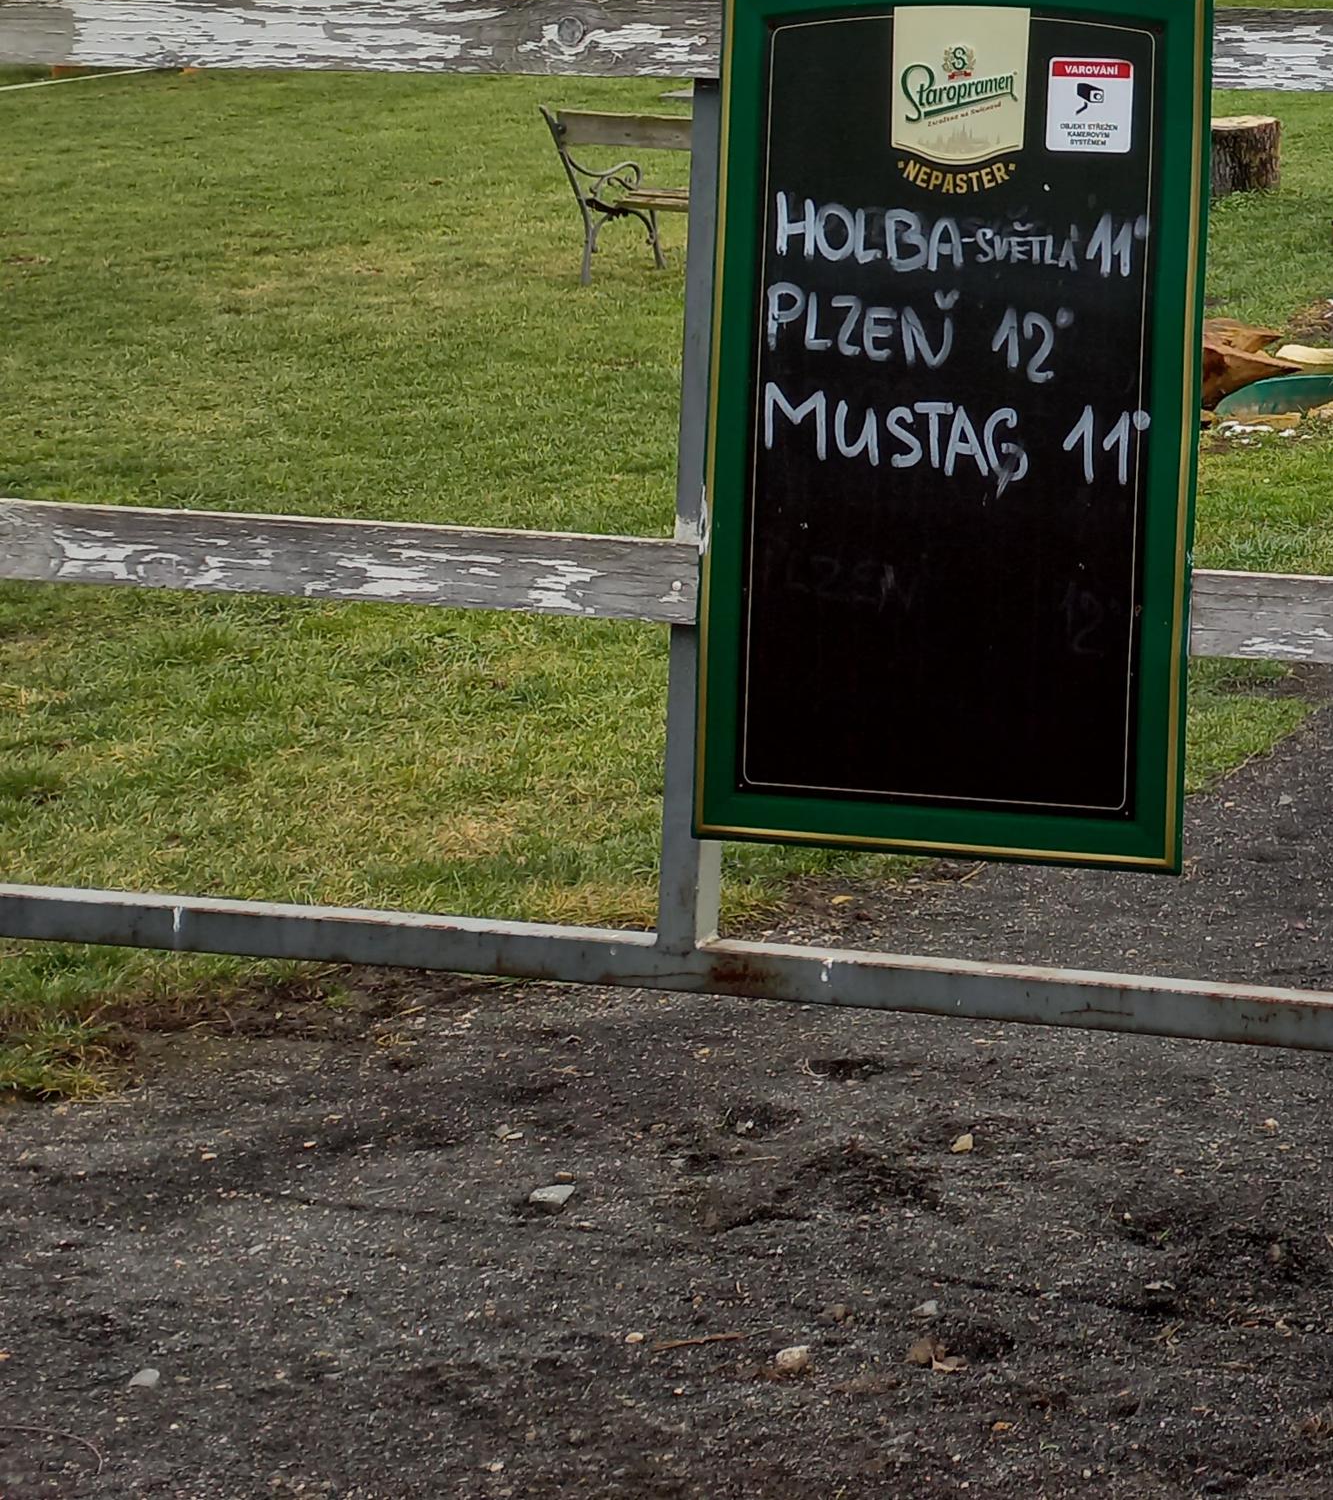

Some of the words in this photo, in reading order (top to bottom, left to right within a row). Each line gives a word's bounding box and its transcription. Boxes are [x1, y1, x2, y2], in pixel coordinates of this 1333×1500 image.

[900, 63, 1017, 123] Staropramen
[1064, 63, 1119, 76] VAROVÁNÍ
[902, 159, 1009, 194] NEPASTER
[767, 281, 960, 371] PLZEŇ
